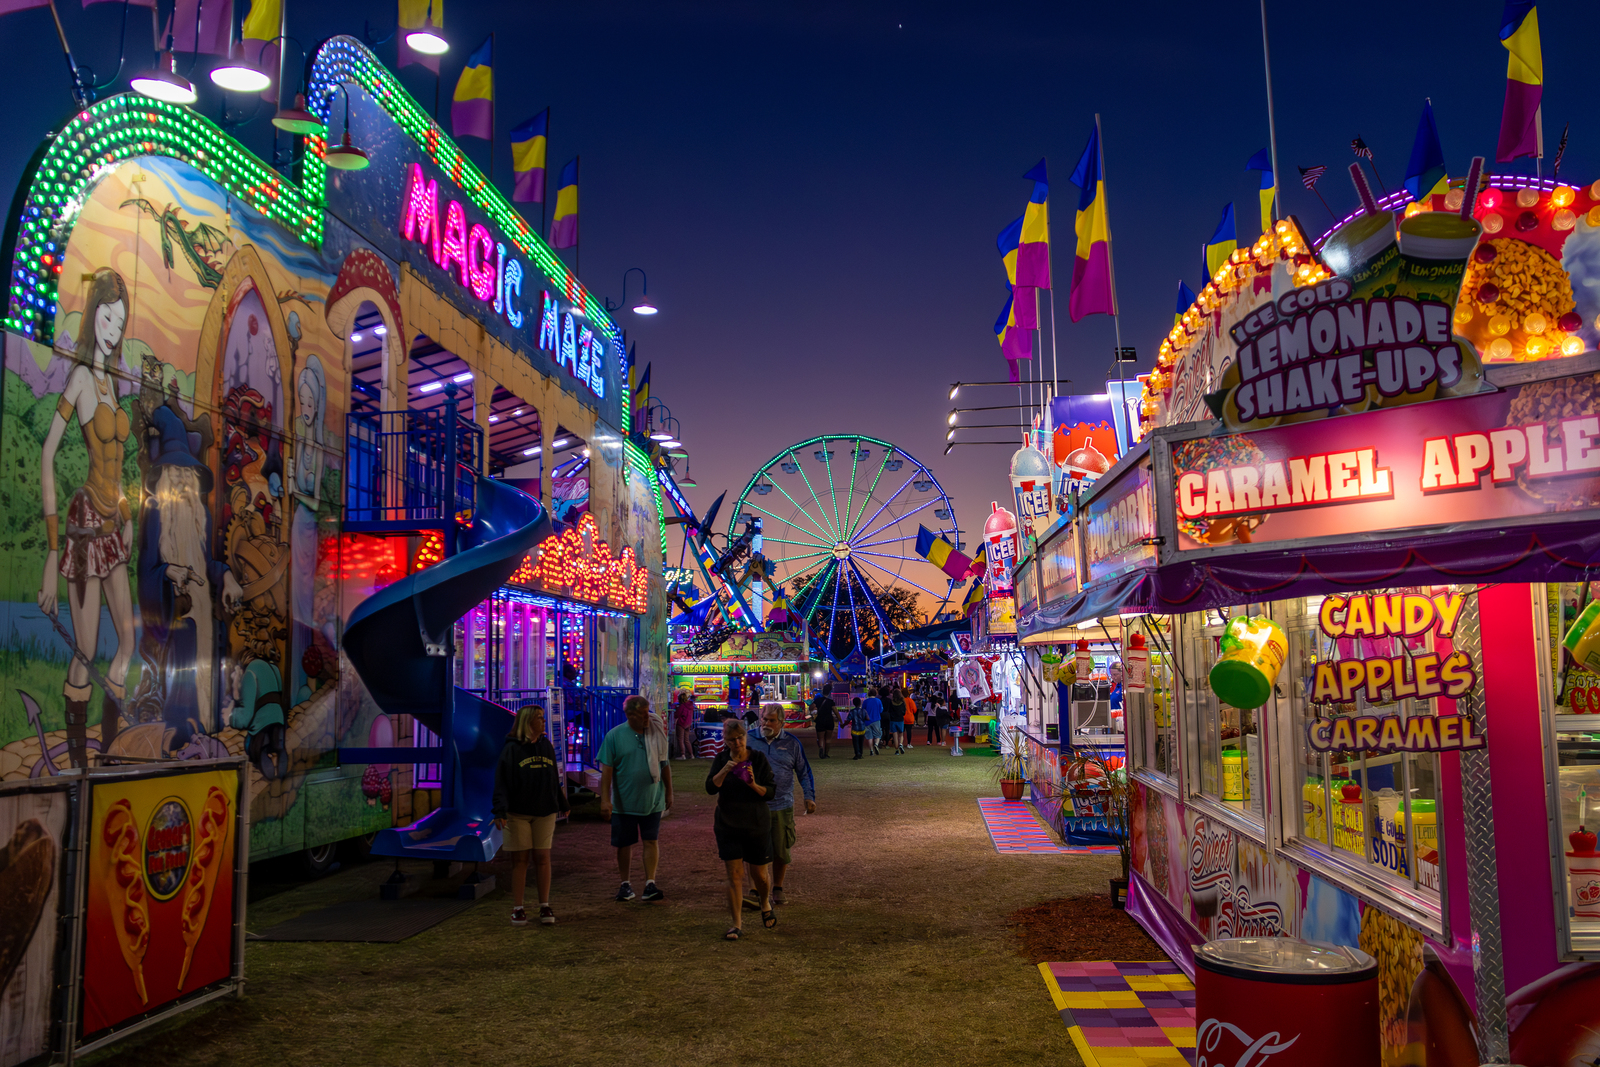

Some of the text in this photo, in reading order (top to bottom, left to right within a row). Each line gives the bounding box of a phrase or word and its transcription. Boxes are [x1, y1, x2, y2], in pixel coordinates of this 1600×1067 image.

[402, 162, 605, 399] MAGIC MAZE
[1353, 246, 1399, 283] LEMONADE
[1410, 263, 1463, 281] LEMONADE
[1233, 279, 1350, 341] ICE COLD
[1238, 301, 1451, 382] LEMONADE
[1237, 345, 1462, 421] SHAKE-UPS
[1017, 489, 1050, 517] ICEE
[1063, 477, 1093, 497] ICE
[1178, 447, 1393, 518] CARAMEL
[1088, 480, 1151, 559] POPCORN
[988, 538, 1016, 561] ICEE
[1319, 593, 1466, 638] CANDY
[682, 665, 730, 673] RIBBON FRIES
[1312, 651, 1477, 703] APPLES
[1308, 715, 1487, 753] CARAMEL
[1332, 804, 1364, 832] ICE COLD
[1190, 817, 1233, 877] Sweet
[1333, 827, 1366, 857] LEMONADE
[1372, 836, 1410, 877] SODA
